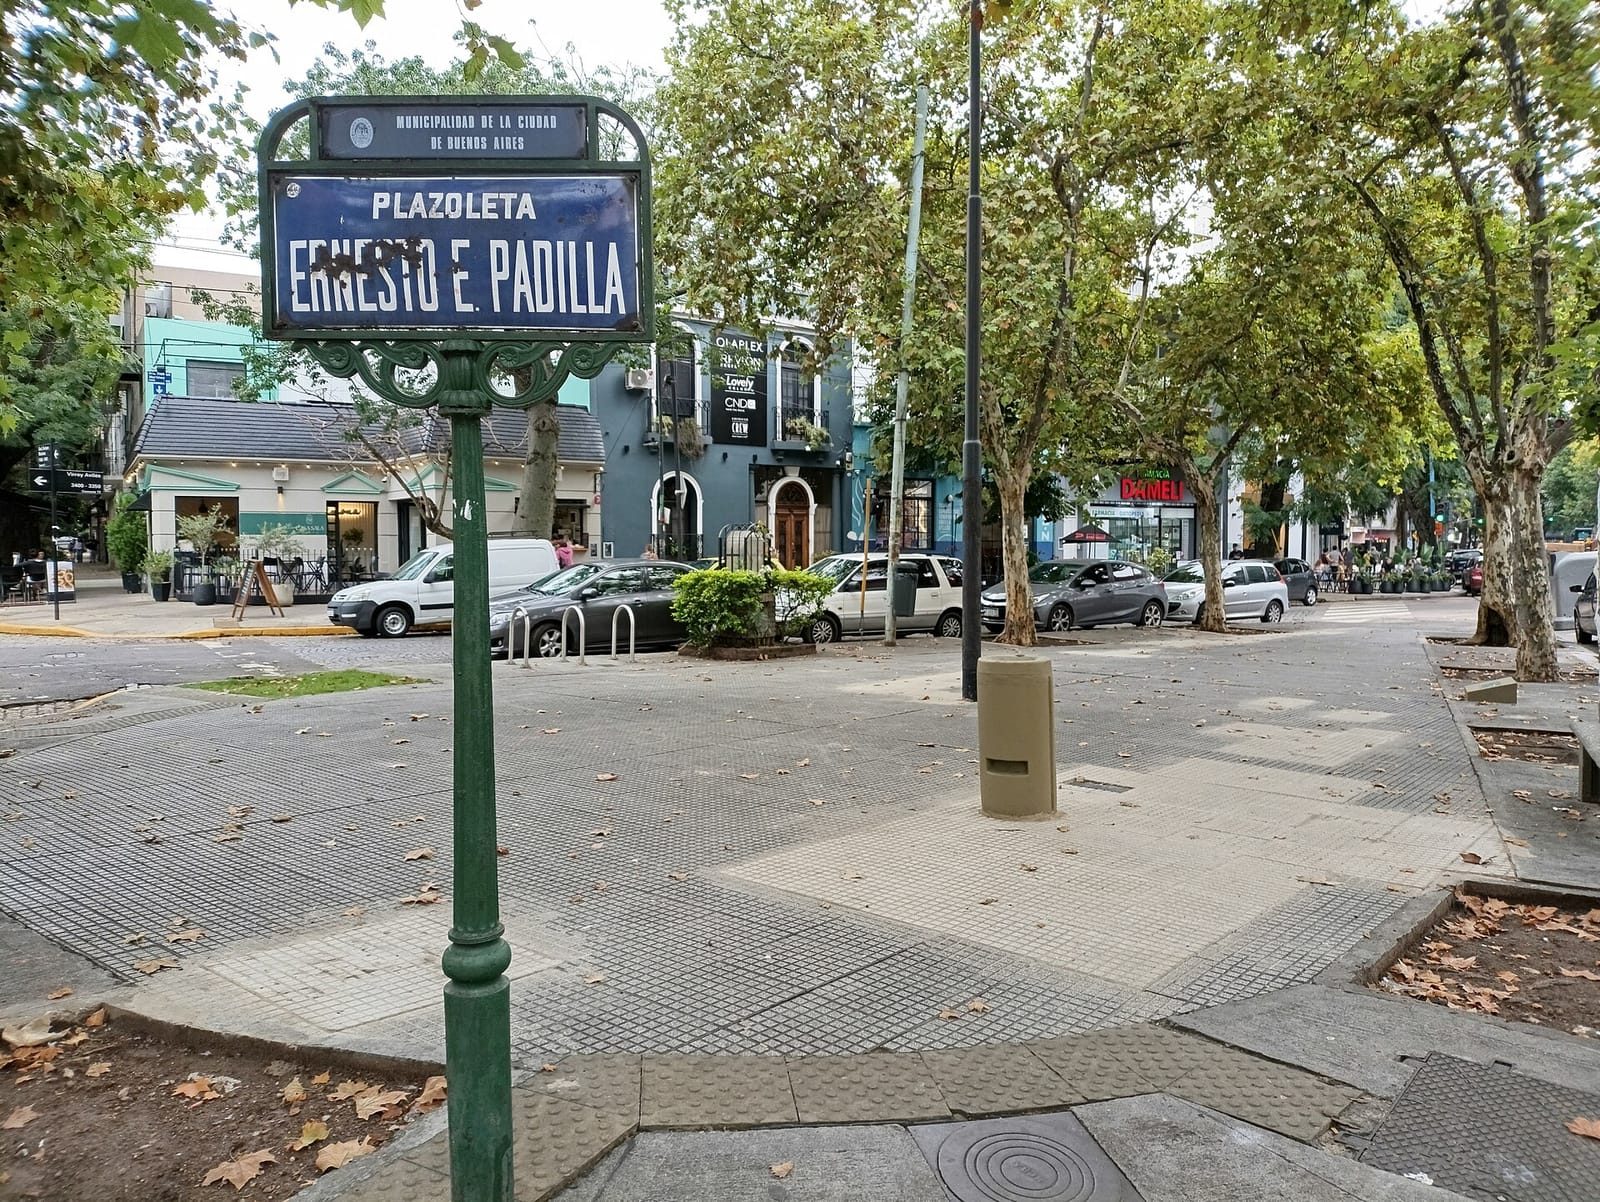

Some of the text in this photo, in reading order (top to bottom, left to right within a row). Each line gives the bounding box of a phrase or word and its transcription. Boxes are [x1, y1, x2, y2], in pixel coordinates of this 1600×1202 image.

[396, 115, 557, 129] MUNICIPALIDAD DE LA CIUDAD
[431, 136, 524, 150] DE BUENOS AIRES
[372, 192, 537, 219] PLAZOLETA
[289, 238, 626, 315] ERNESTO E. PADILLA
[726, 375, 754, 391] Lovely
[724, 397, 748, 409] CND
[1121, 478, 1184, 501] DAMELI
